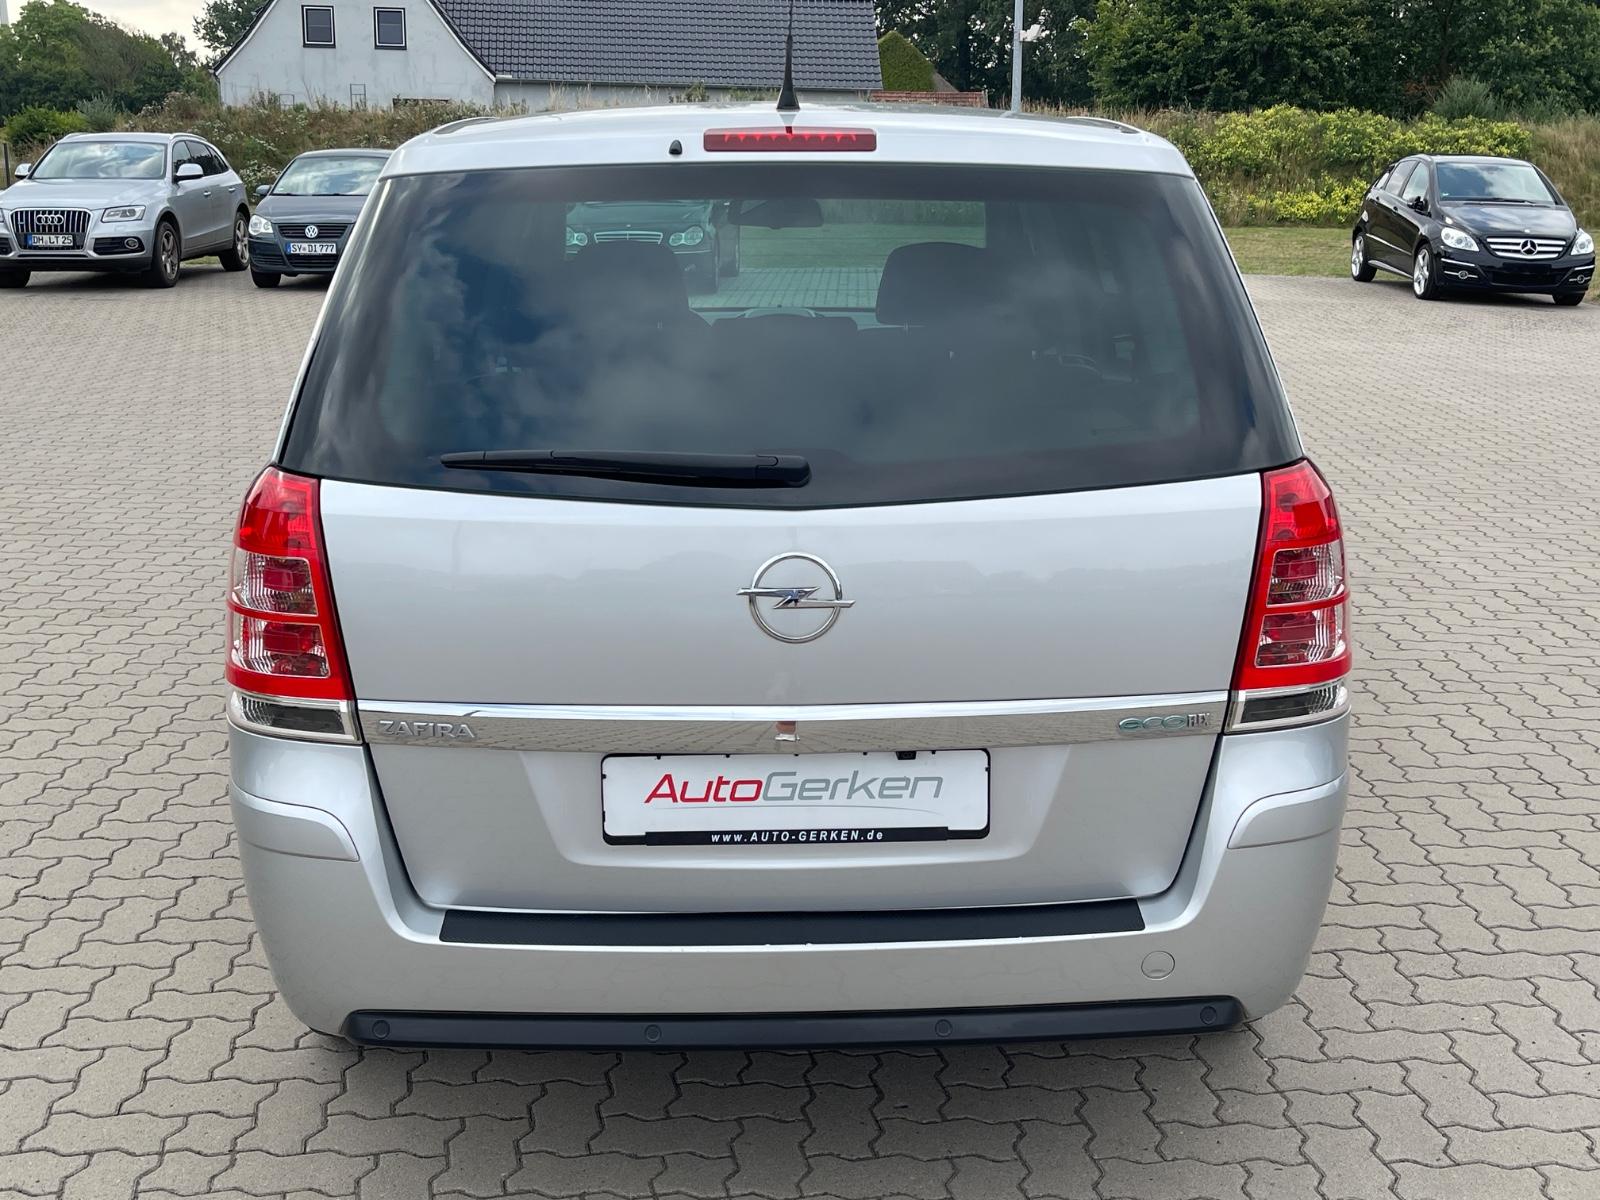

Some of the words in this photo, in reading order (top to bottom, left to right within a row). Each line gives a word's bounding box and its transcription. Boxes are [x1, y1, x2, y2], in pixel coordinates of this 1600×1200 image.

[32, 235, 44, 244] DH
[48, 235, 60, 244] LT
[61, 235, 73, 244] 25
[291, 244, 302, 253] SY
[307, 244, 317, 253] DI
[319, 244, 335, 253] 777
[378, 720, 476, 738] ZAFIRA
[710, 829, 885, 843] www.AUTO-GERKEN.de
